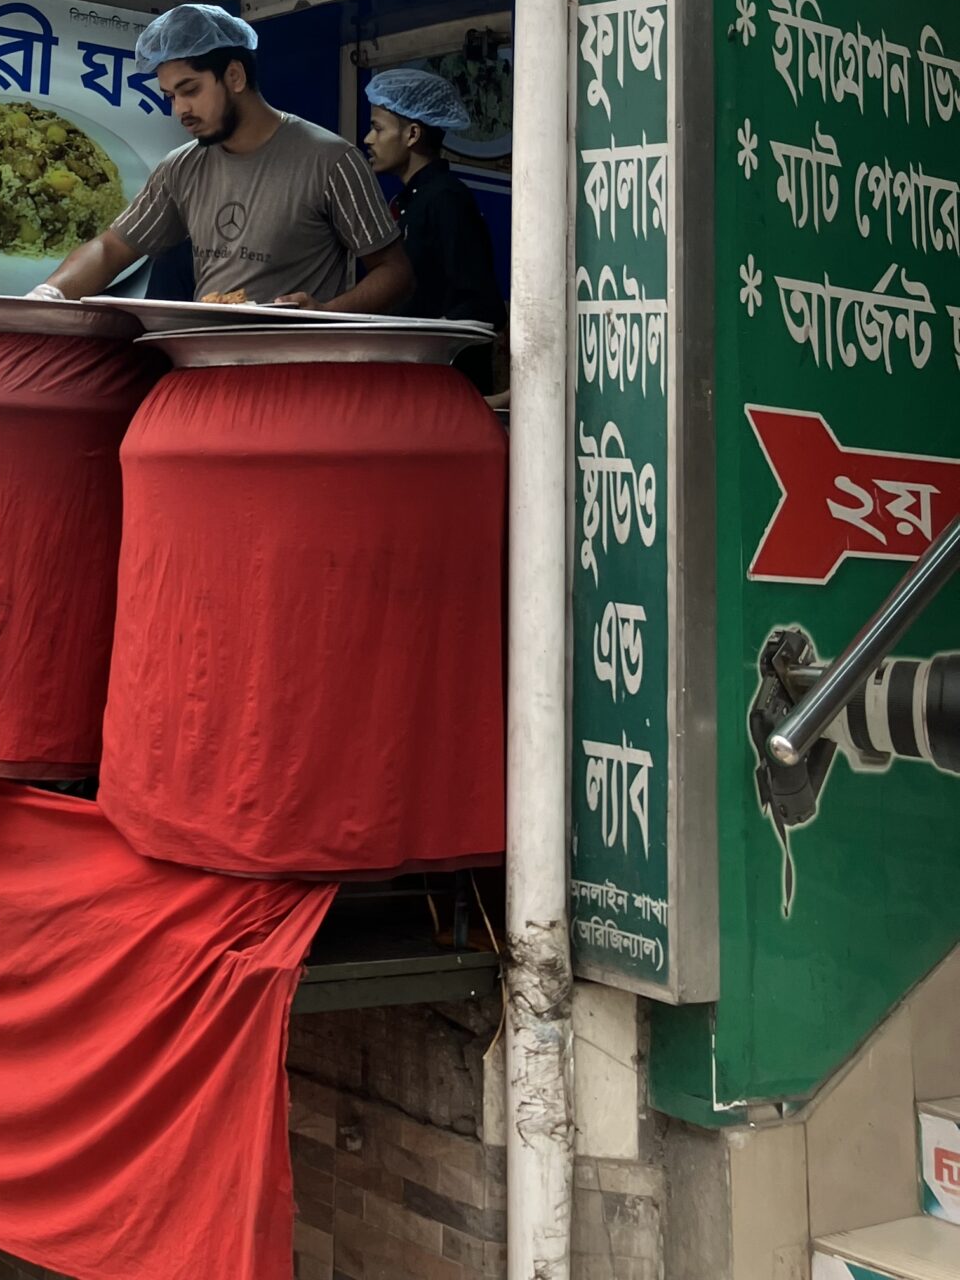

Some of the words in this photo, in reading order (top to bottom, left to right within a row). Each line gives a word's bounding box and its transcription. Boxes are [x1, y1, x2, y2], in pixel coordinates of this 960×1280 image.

[581, 131, 668, 241] কালার
[770, 121, 842, 234] ম্যাট
[575, 265, 668, 398] ডিজিটাল
[774, 263, 936, 376] আর্জেন্ট
[827, 476, 942, 545] ২য়
[593, 602, 646, 703] এন্ড
[583, 730, 653, 860] ল্যাব
[632, 892, 668, 927] শাখা
